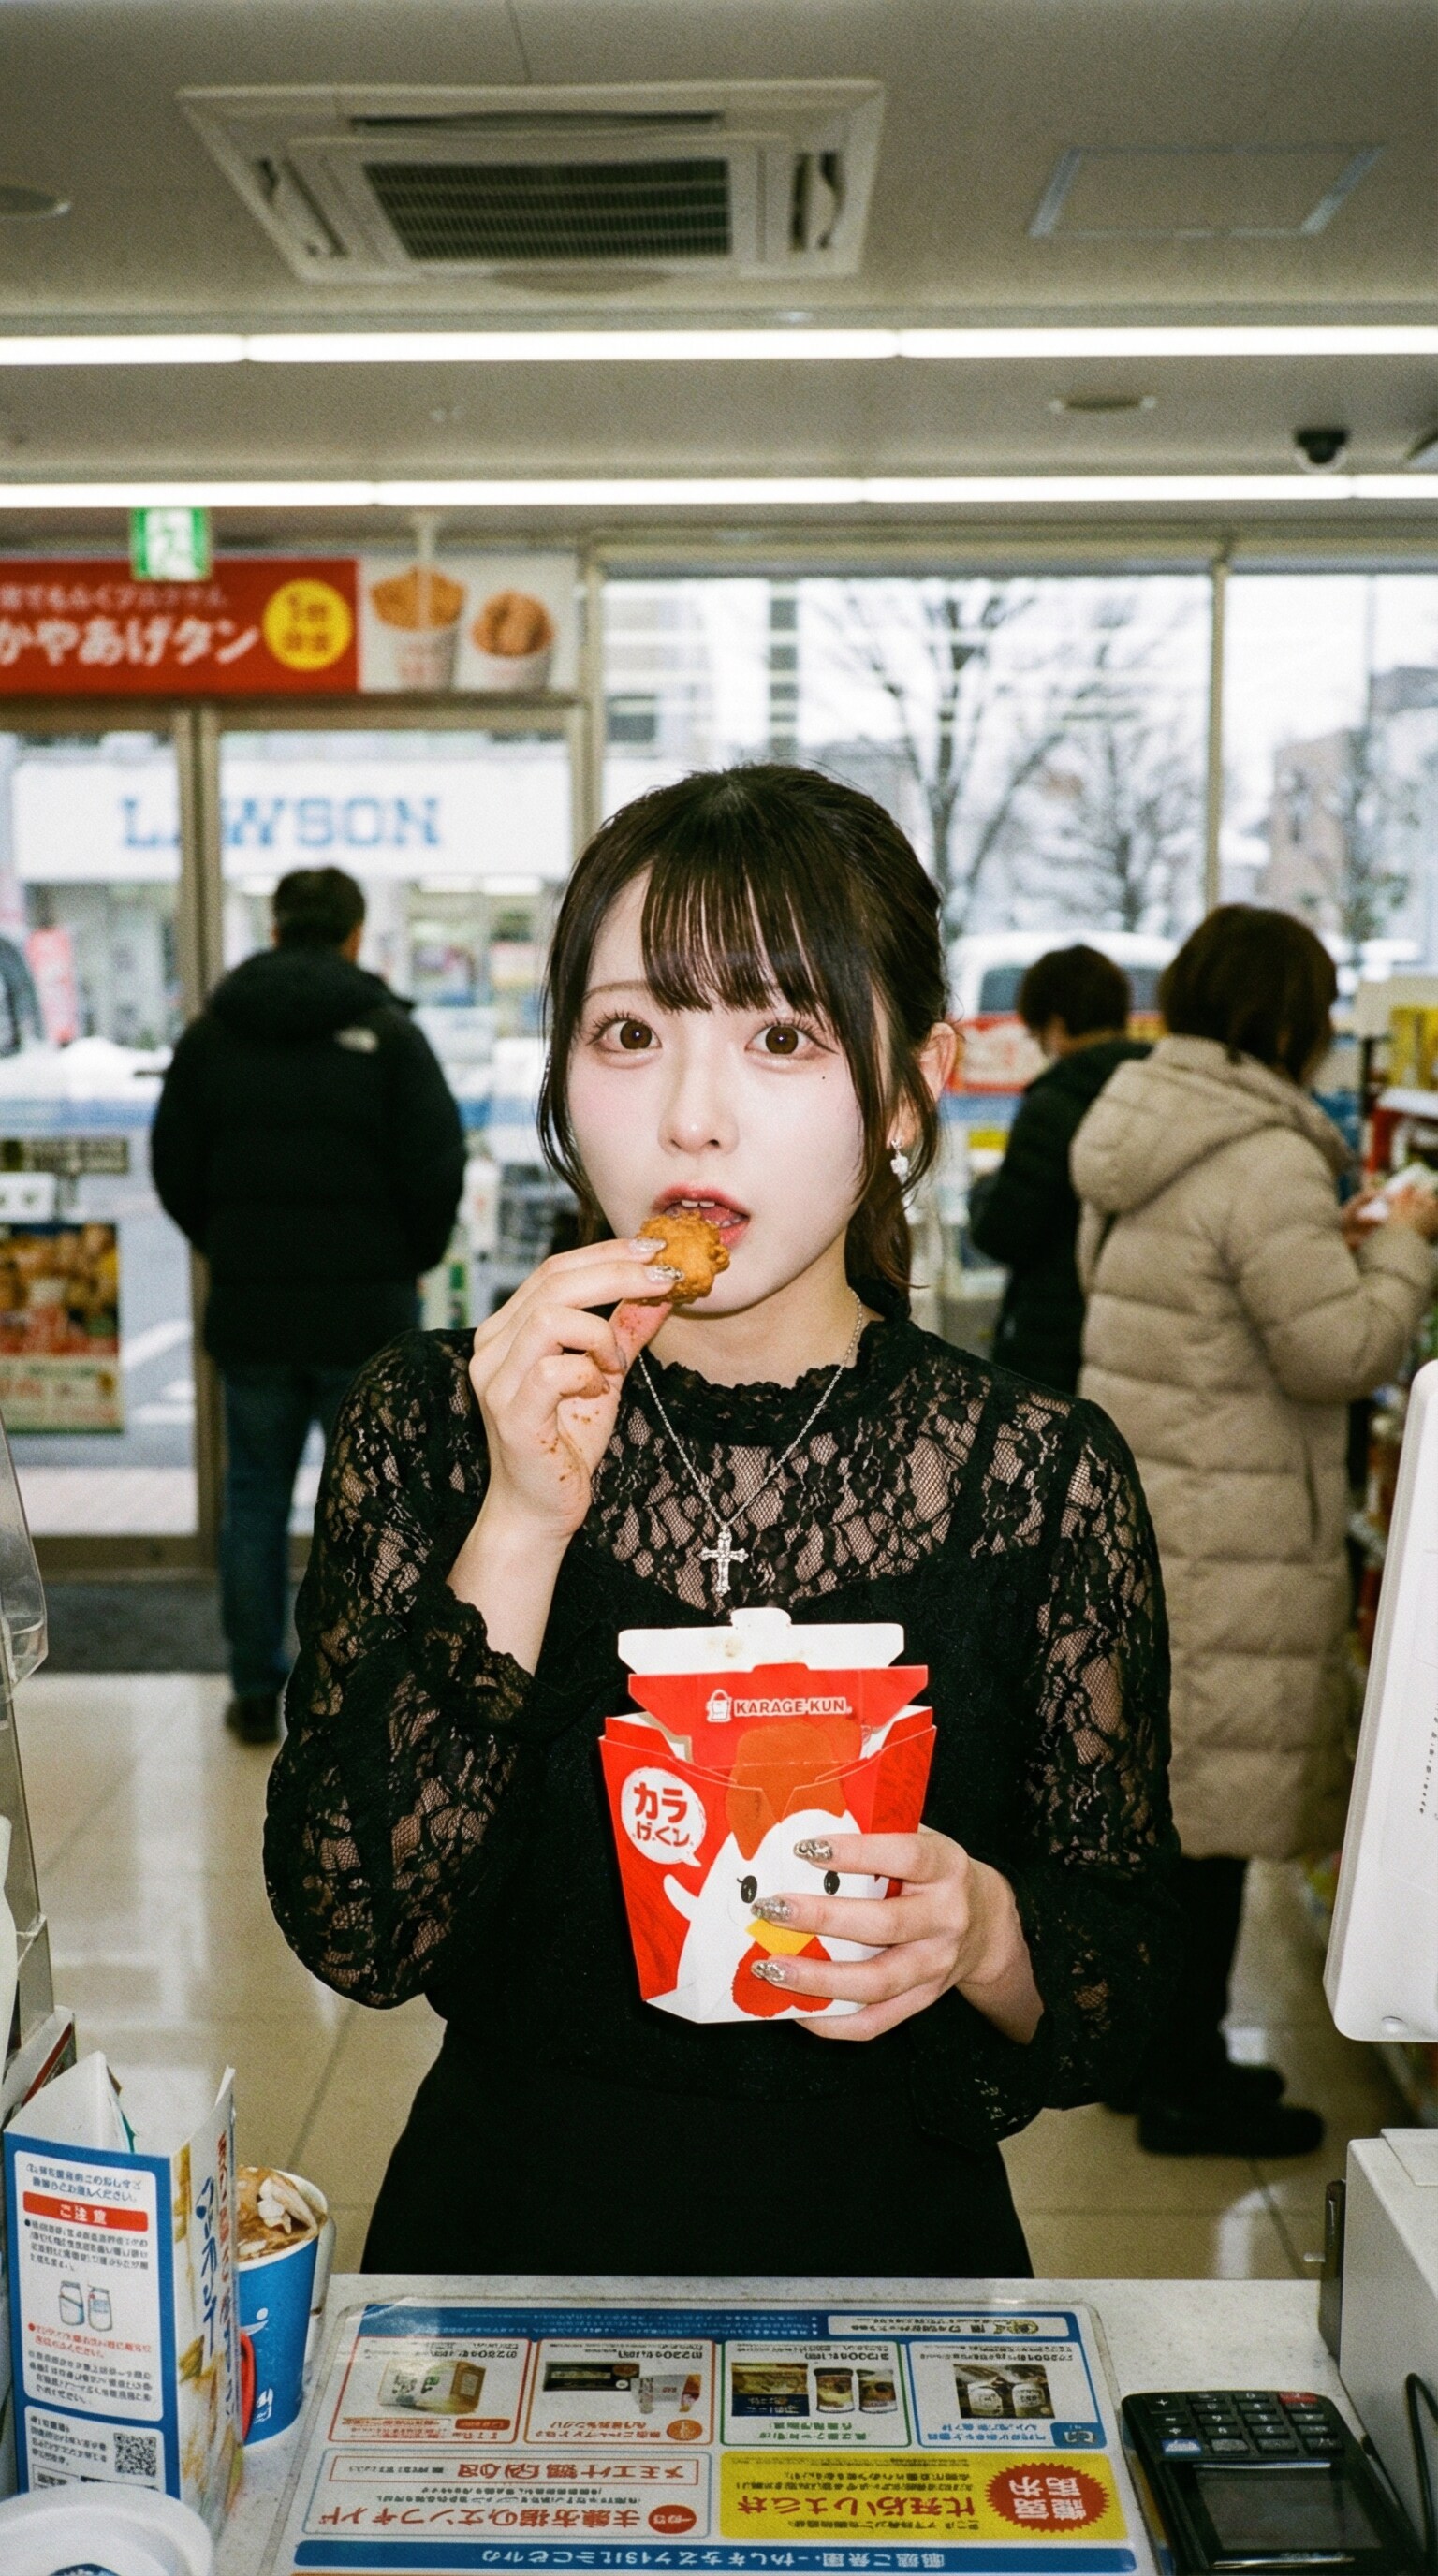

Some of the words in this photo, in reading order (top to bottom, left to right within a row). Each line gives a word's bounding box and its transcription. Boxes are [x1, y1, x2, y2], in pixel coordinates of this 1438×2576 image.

[121, 794, 440, 847] LWSON
[735, 1699, 804, 1715] KARAGE
[809, 1698, 846, 1713] KUN
[634, 1781, 688, 1823] カラ
